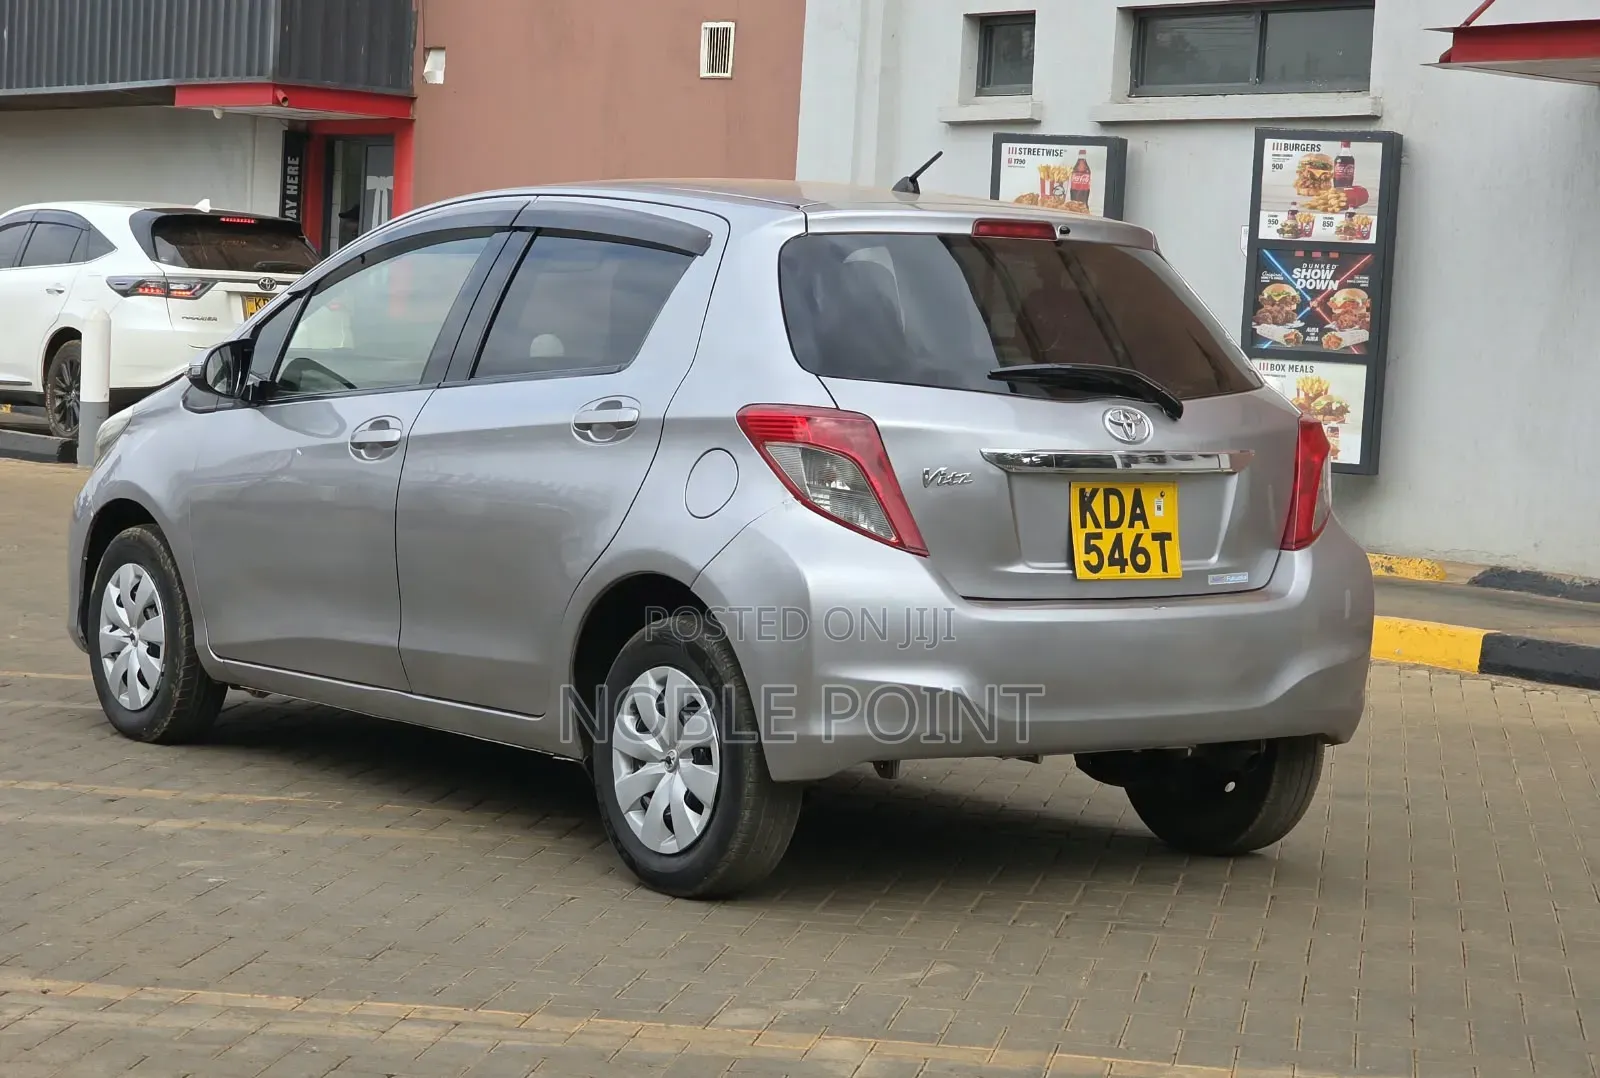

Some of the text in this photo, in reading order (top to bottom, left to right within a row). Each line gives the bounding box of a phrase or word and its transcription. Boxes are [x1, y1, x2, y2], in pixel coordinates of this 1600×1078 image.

[1018, 146, 1064, 158] STREETWISE
[1283, 142, 1321, 152] BURGERS
[285, 156, 300, 220] AY HERE
[1322, 220, 1334, 228] 850
[1292, 267, 1335, 280] SHOW
[1295, 279, 1340, 290] DOWN
[1270, 363, 1315, 374] BOX MEALS
[922, 466, 973, 488] Vitz
[1078, 487, 1150, 530] KDA
[1082, 531, 1172, 575] 546T
